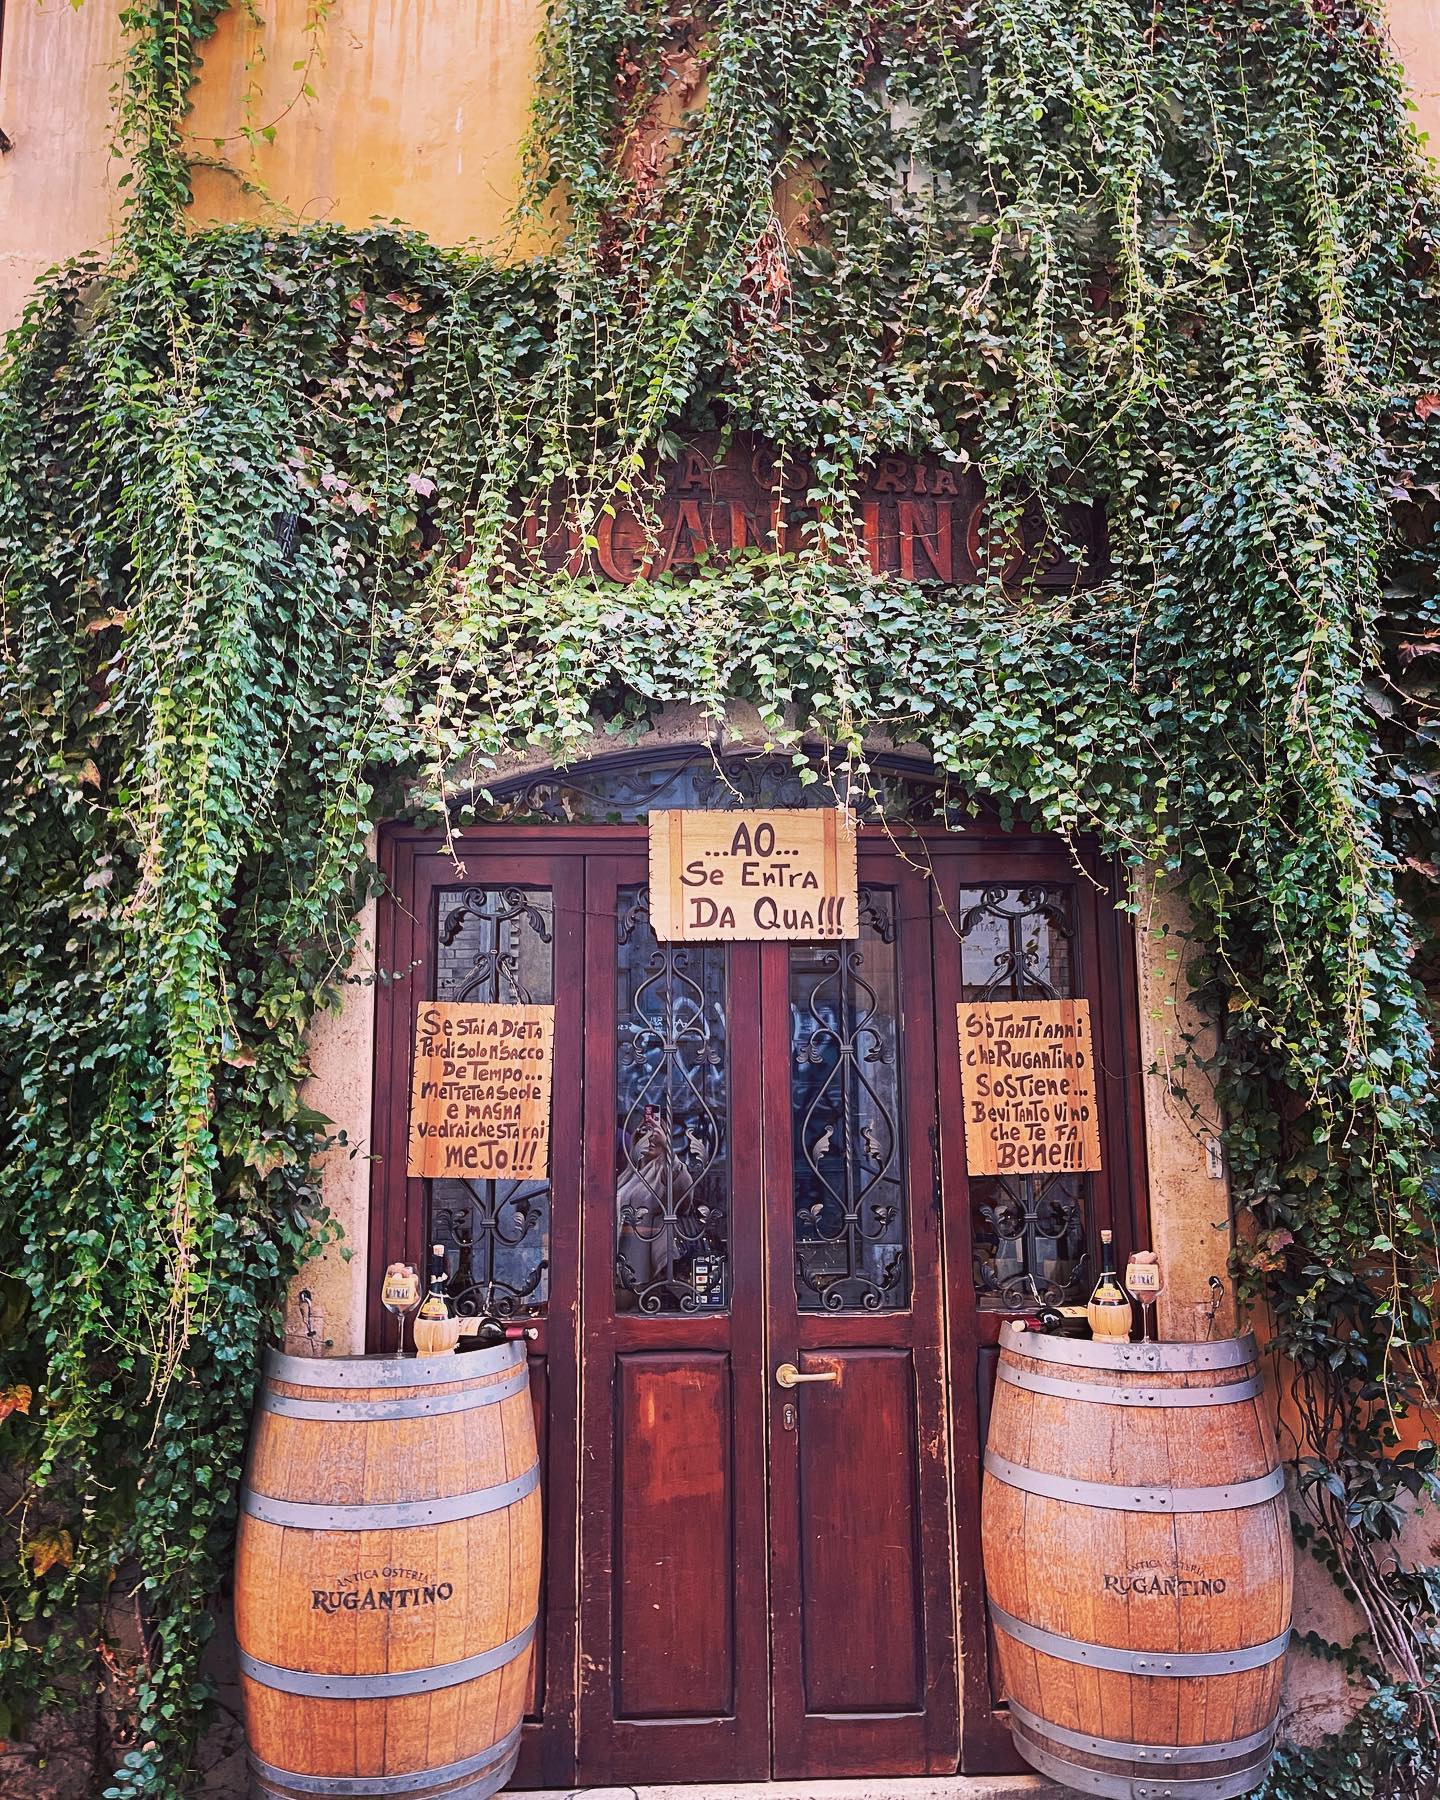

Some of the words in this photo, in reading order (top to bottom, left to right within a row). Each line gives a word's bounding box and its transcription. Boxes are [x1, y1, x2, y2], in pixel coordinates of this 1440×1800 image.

[678, 861, 725, 887] Se
[422, 1009, 453, 1036] Se
[336, 1569, 379, 1587] ANTICA
[381, 1566, 430, 1585] OSTERIA
[1103, 1575, 1226, 1598] RUGANTINO
[311, 1582, 453, 1614] RUGANTINO
